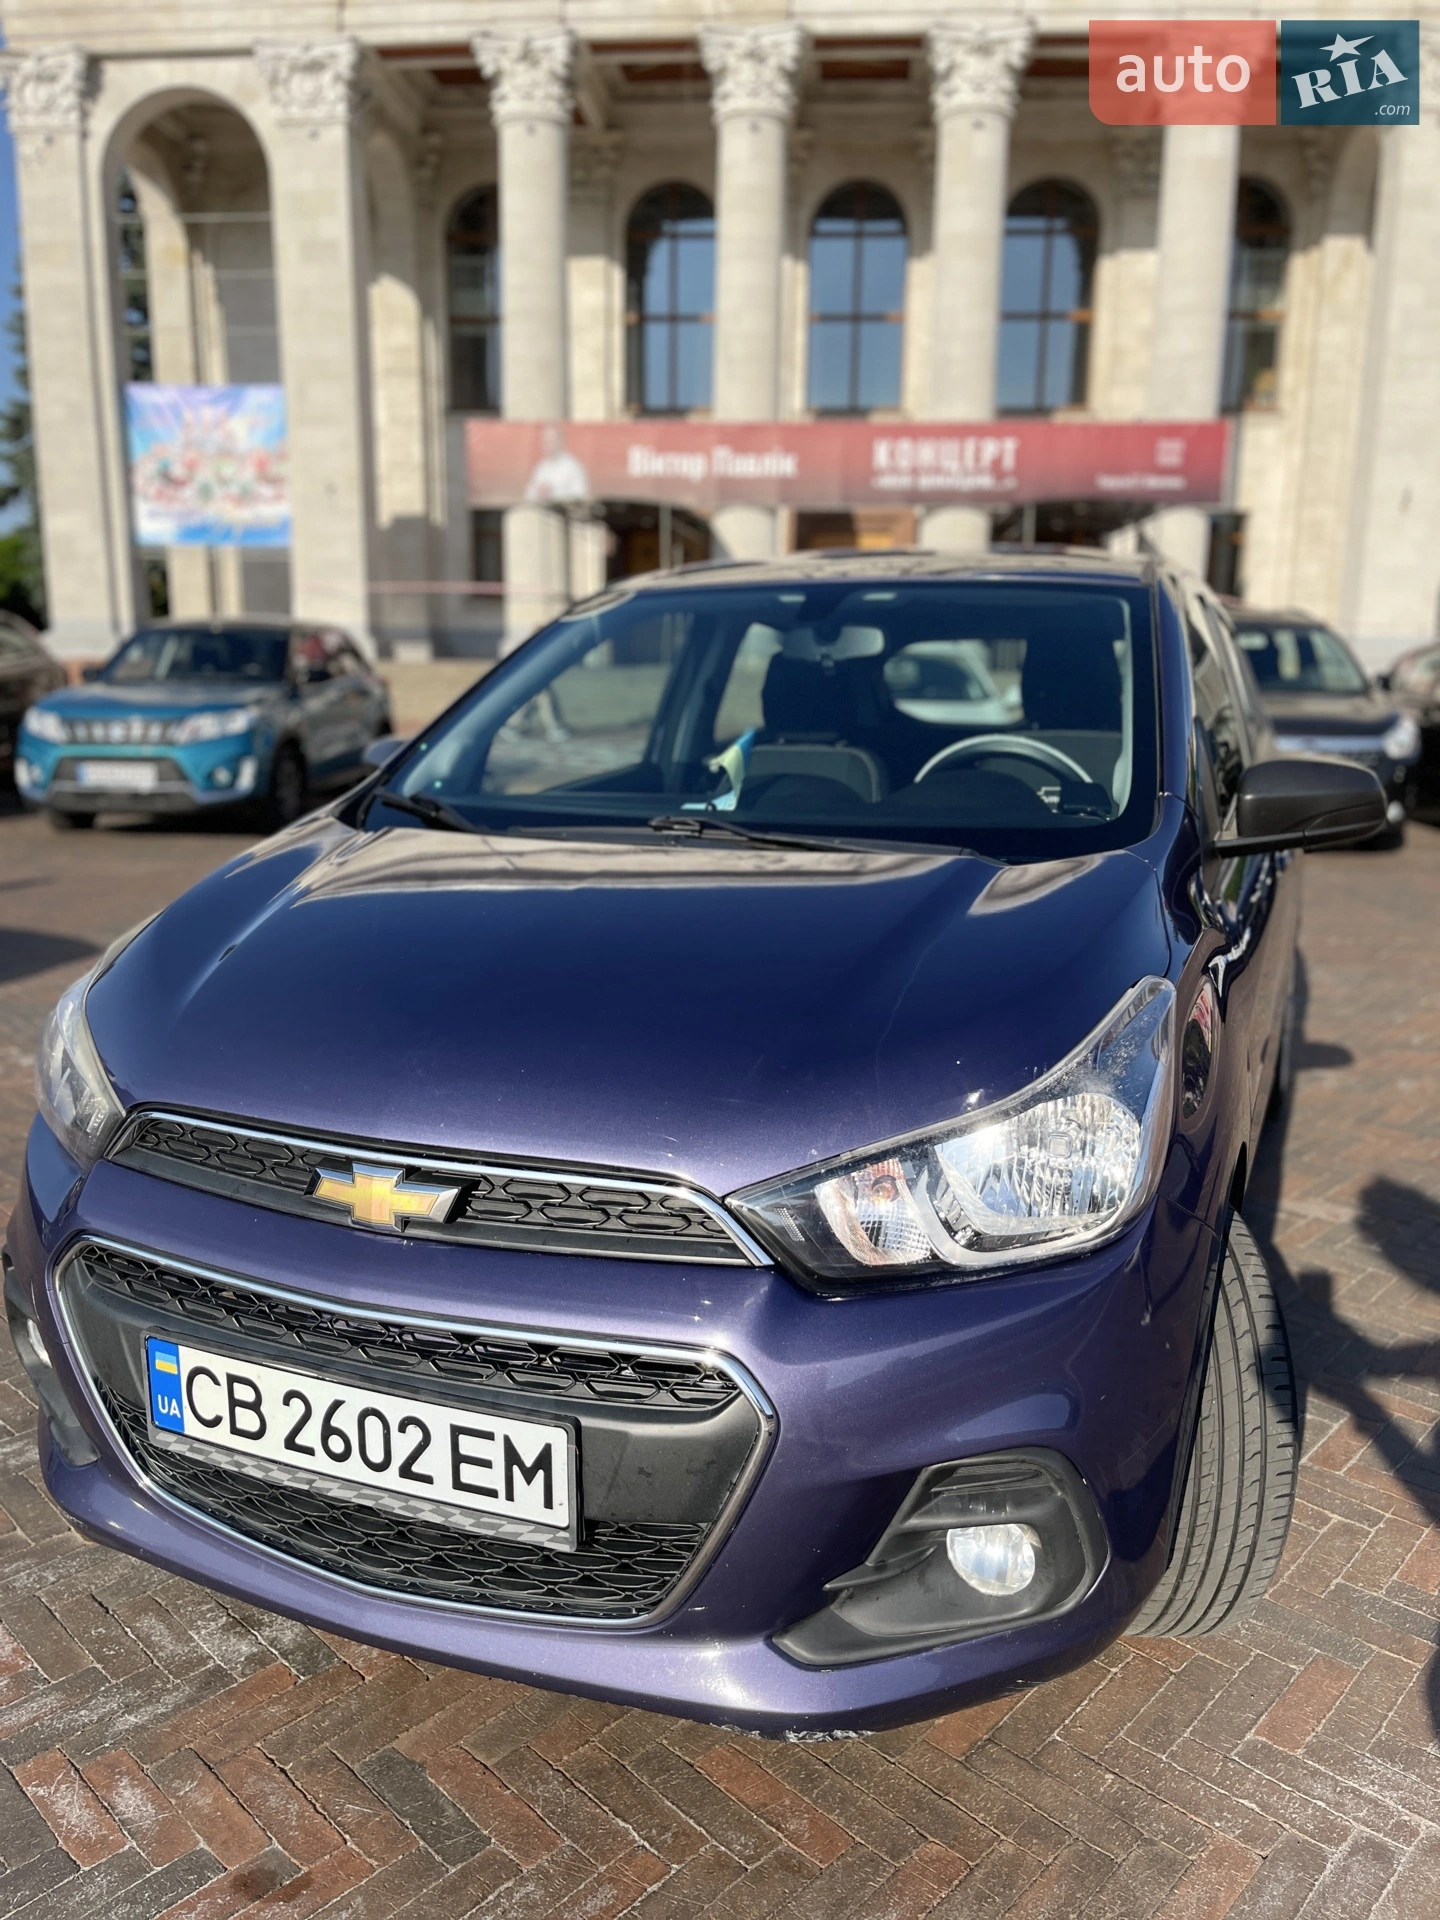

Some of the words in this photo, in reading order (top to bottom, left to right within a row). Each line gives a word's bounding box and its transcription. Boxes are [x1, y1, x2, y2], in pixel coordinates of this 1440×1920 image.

[873, 438, 1018, 472] КОНЦЕРТ
[158, 1394, 181, 1419] UA
[186, 1365, 268, 1441] CB
[282, 1389, 434, 1485] 2602
[449, 1423, 553, 1510] EM
